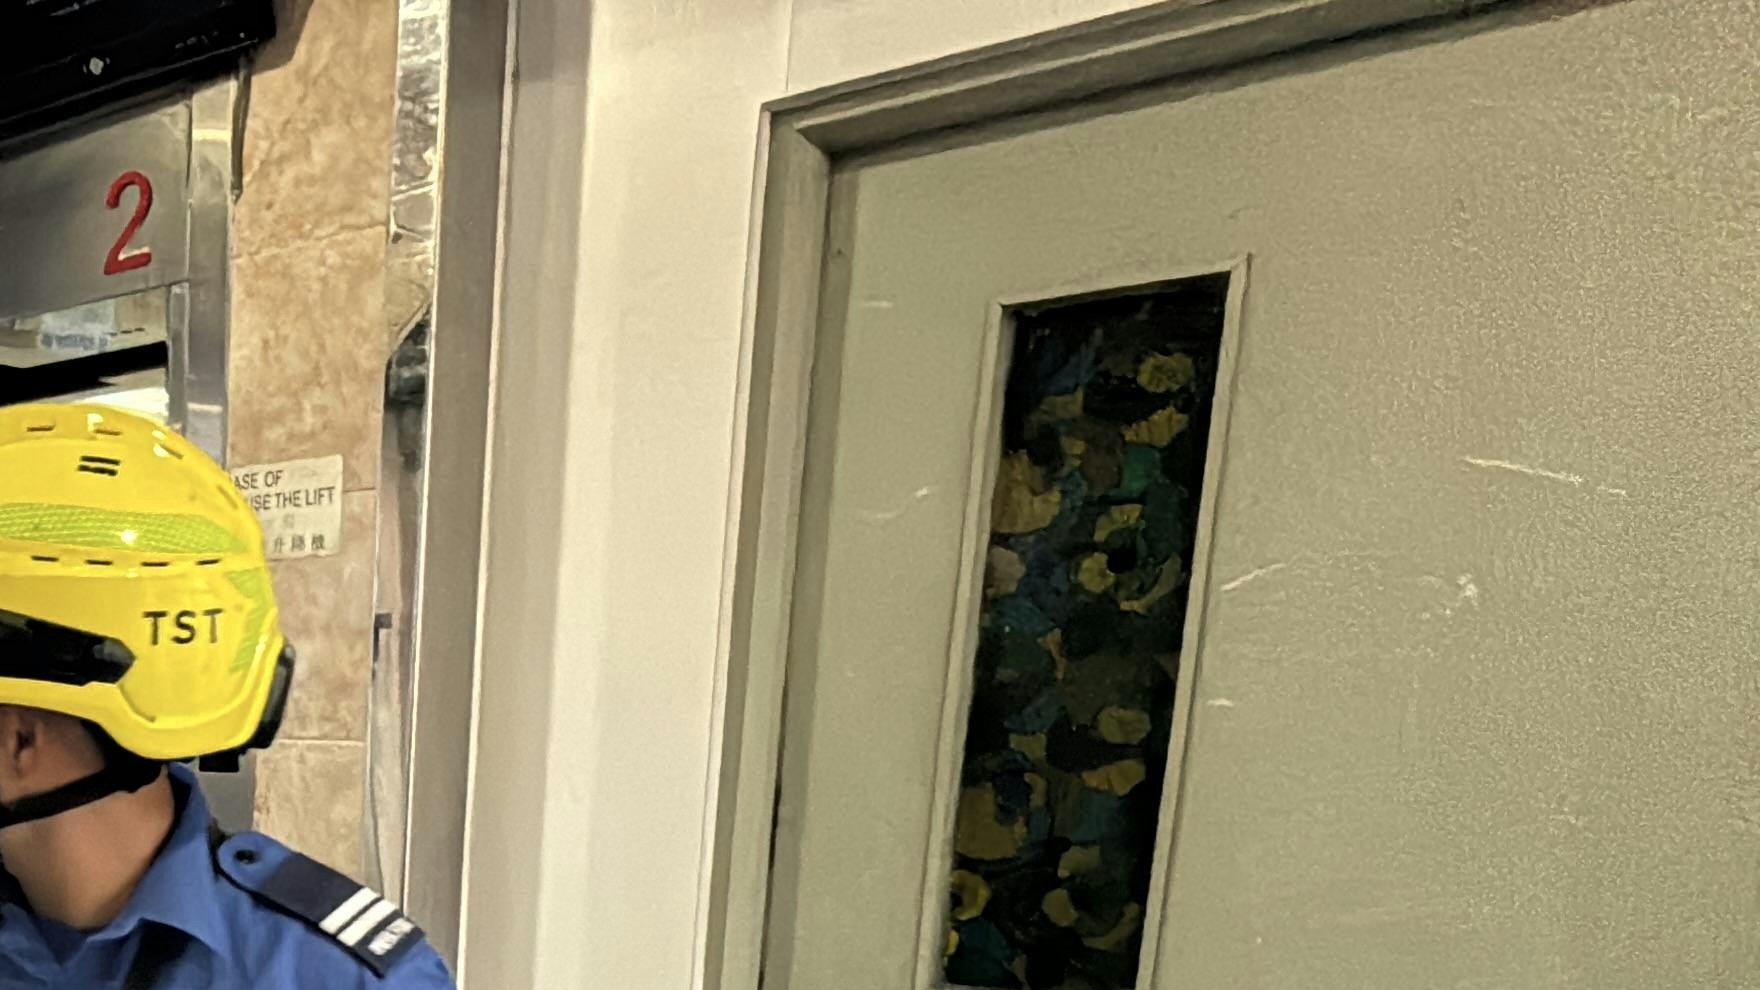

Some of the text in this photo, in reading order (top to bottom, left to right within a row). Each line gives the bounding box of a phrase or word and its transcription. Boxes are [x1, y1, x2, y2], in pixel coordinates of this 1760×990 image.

[104, 170, 153, 275] 2
[233, 469, 284, 490] ASE OF
[275, 489, 302, 509] THE
[305, 486, 335, 506] LIFT
[142, 607, 225, 646] TST
